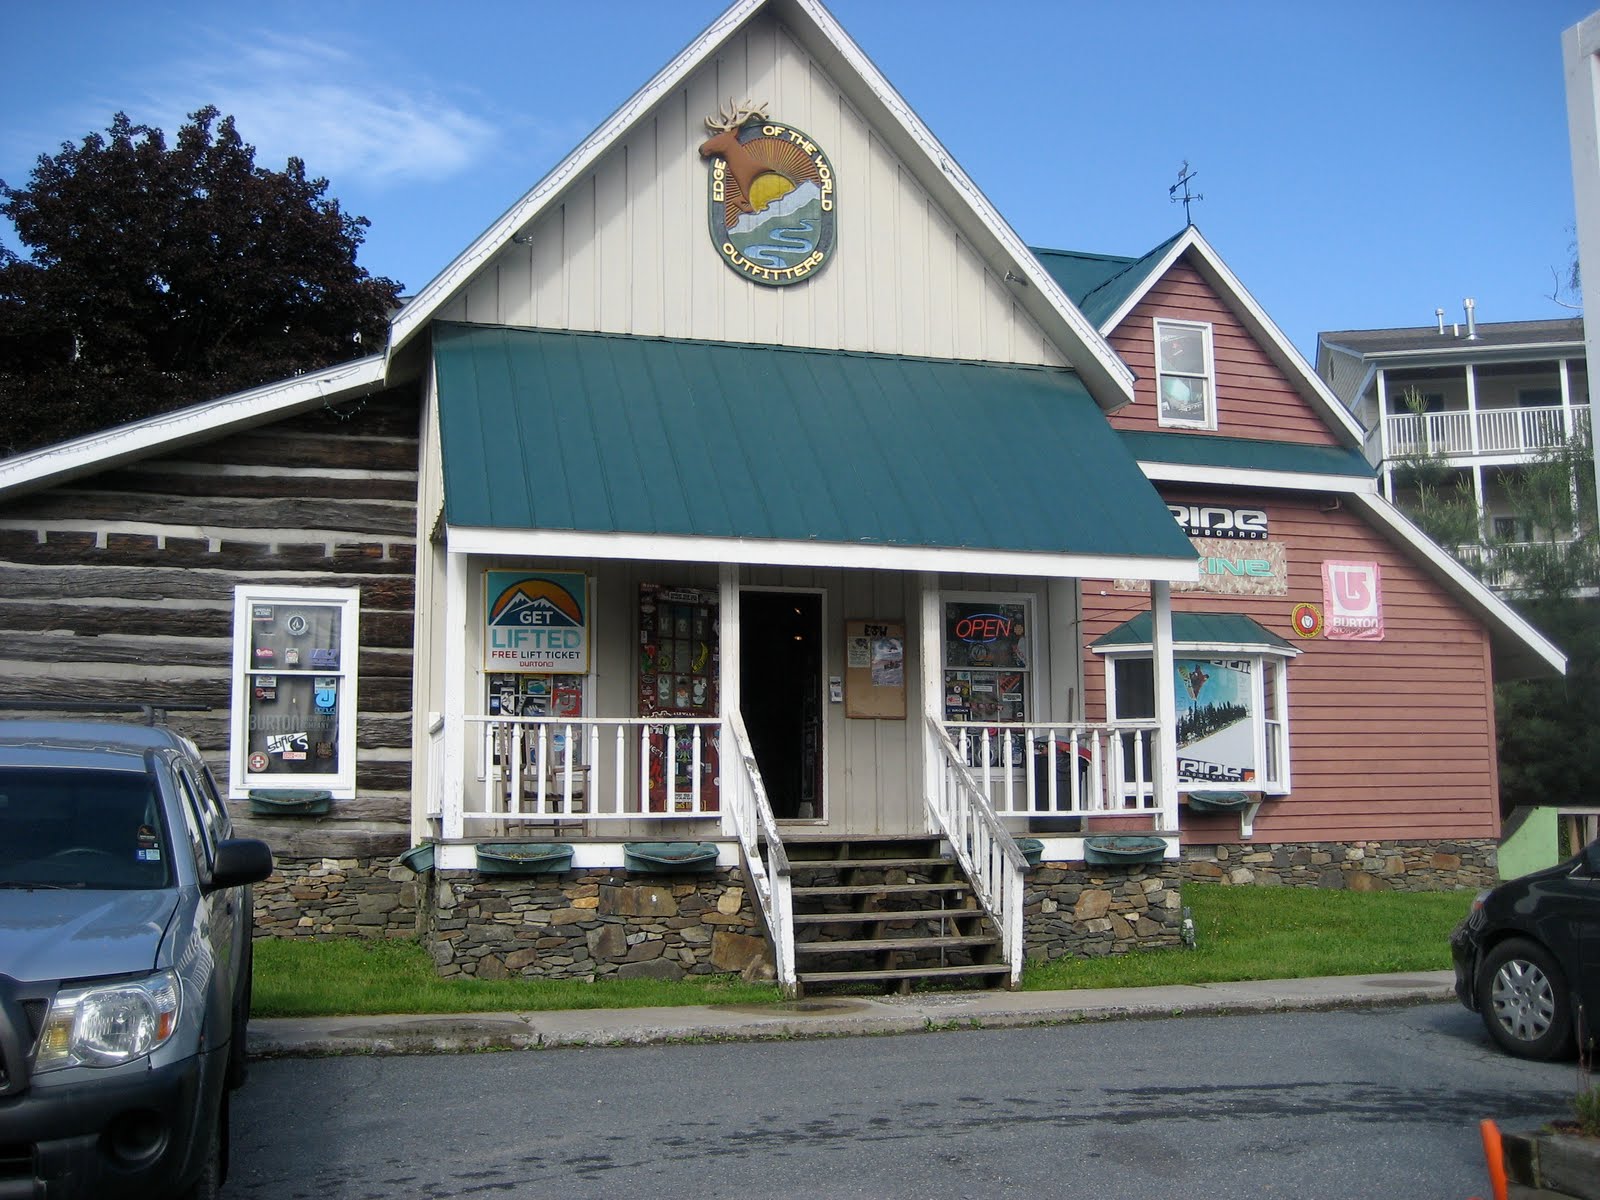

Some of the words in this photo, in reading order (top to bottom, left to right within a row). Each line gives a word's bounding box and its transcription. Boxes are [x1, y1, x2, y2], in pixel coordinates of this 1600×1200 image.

[713, 158, 726, 202] EDGE
[762, 125, 786, 137] OF
[788, 130, 818, 155] THE
[814, 155, 833, 212] WORLD
[722, 243, 825, 281] OUTFITTERS
[1182, 528, 1268, 539] WBOARDS
[519, 610, 554, 625] GET
[1332, 616, 1379, 628] BURTON
[956, 619, 1011, 638] OPEN
[491, 629, 581, 649] LIFTED
[491, 650, 518, 659] FREE
[520, 651, 543, 659] LIFT
[545, 651, 581, 660] TICKET
